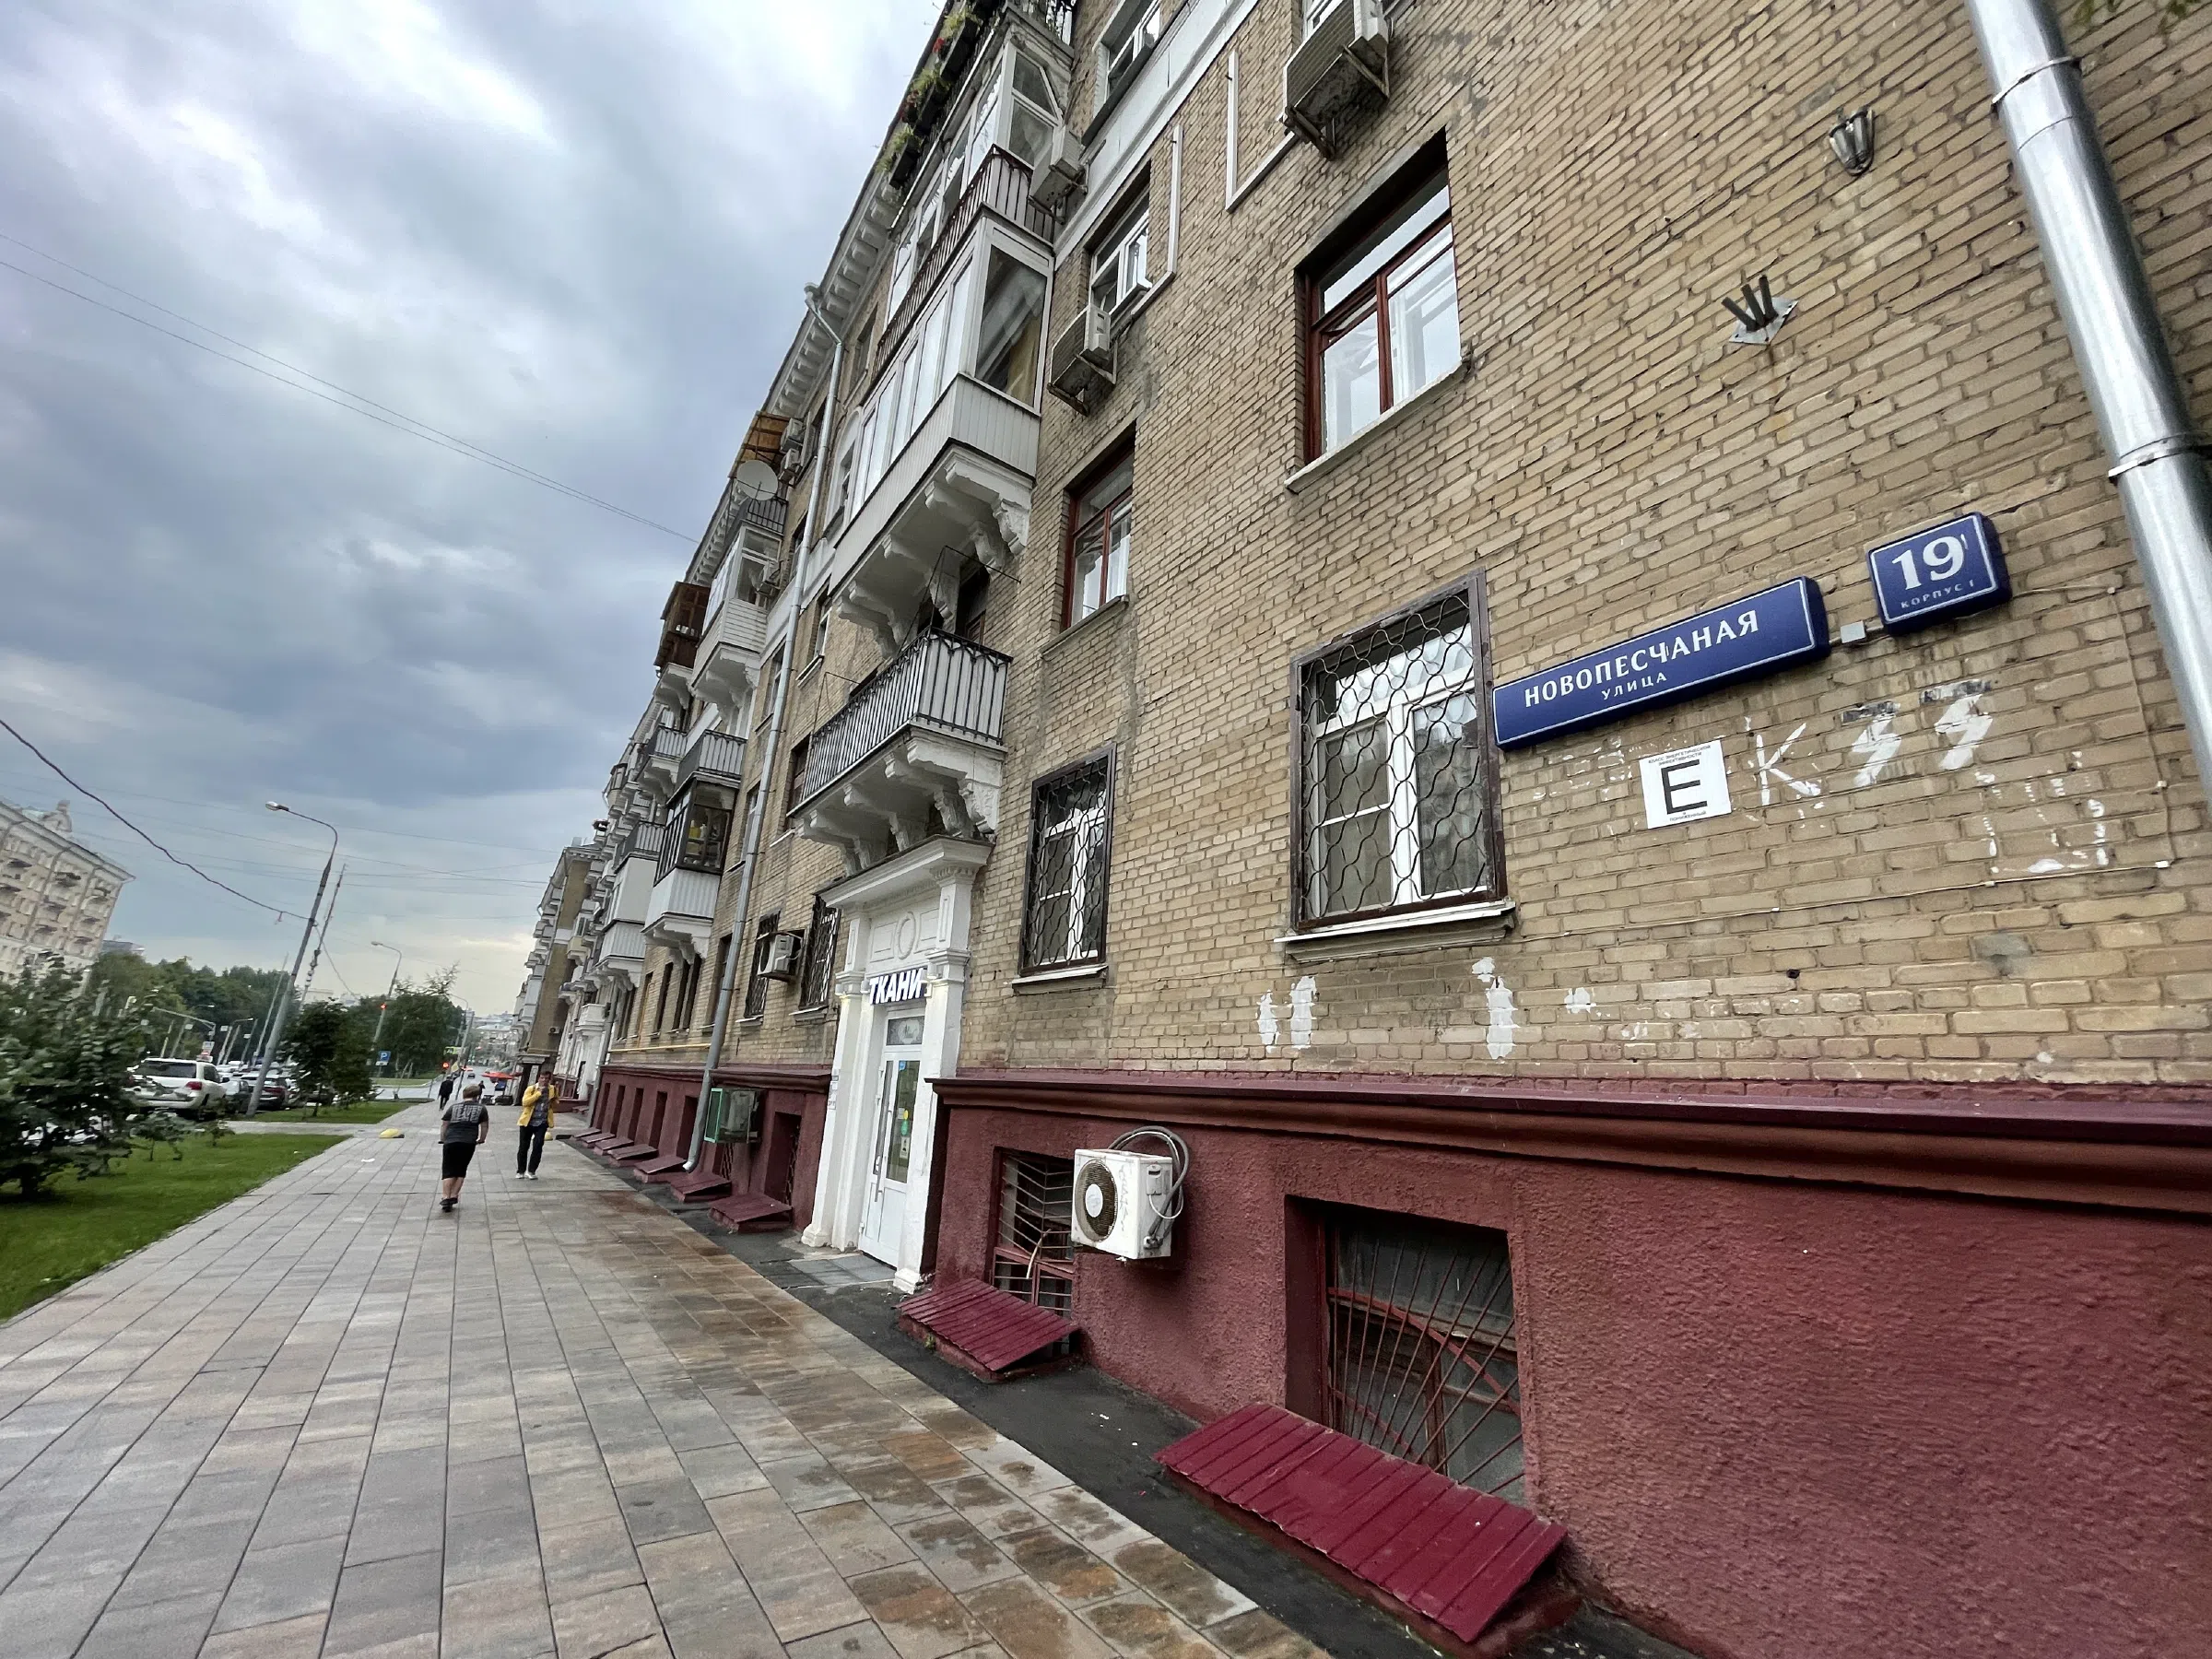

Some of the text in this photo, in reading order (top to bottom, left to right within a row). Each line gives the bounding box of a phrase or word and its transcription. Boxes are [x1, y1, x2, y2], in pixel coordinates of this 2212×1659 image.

[1891, 535, 1965, 590] 19
[1900, 583, 1963, 608] КОРПУС
[1524, 609, 1759, 708] НОВОПЕСЧАНАЯ
[1601, 672, 1667, 700] УЛИЦА
[1661, 759, 1708, 815] Е
[869, 968, 924, 1005] ТКАНИ
